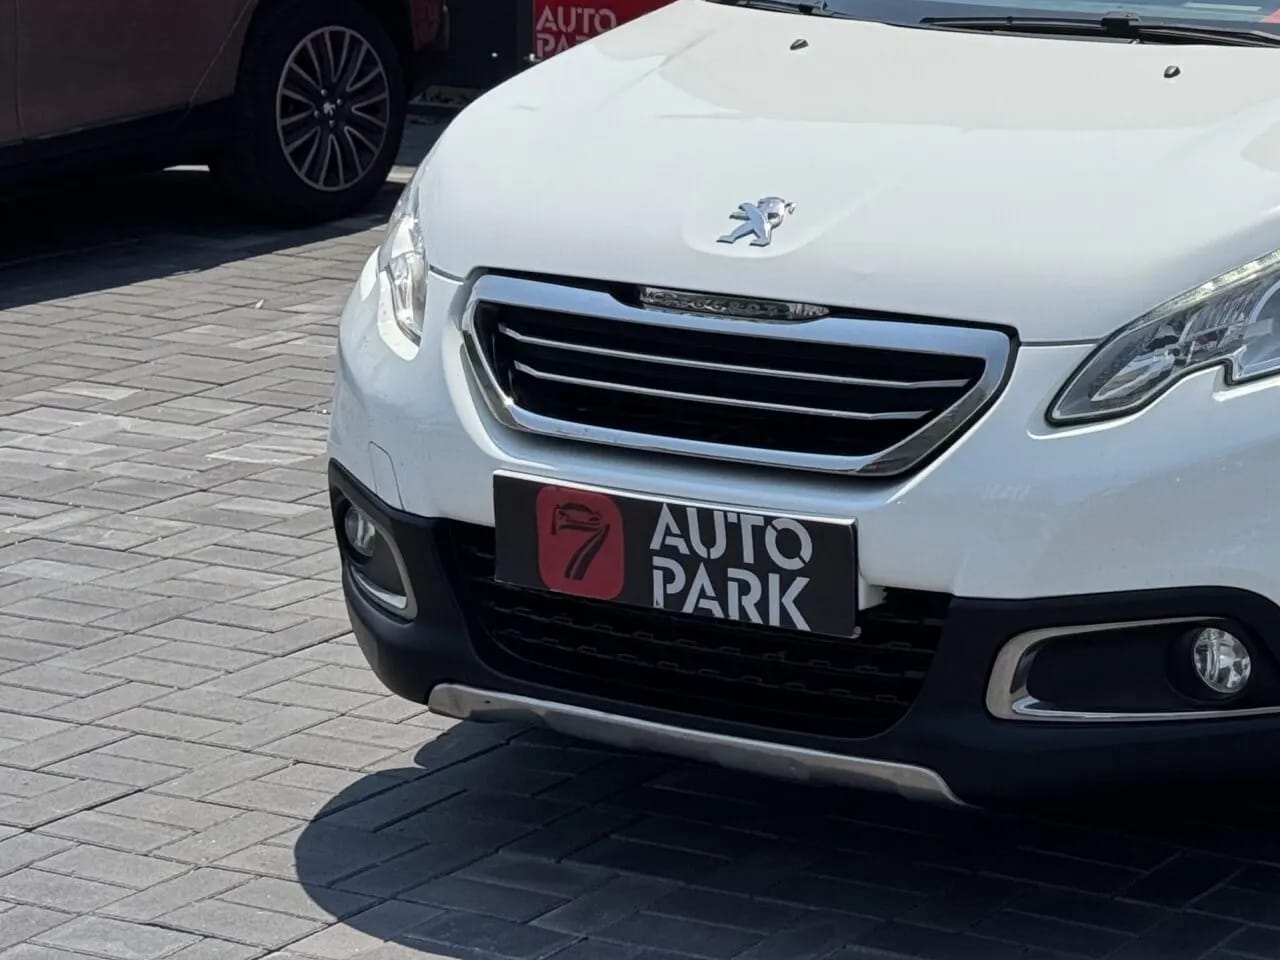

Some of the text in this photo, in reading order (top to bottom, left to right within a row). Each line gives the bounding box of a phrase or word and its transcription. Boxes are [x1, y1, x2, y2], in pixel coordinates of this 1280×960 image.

[535, 5, 617, 35] AUTO
[650, 502, 813, 571] AUTO
[652, 556, 812, 632] PARK
